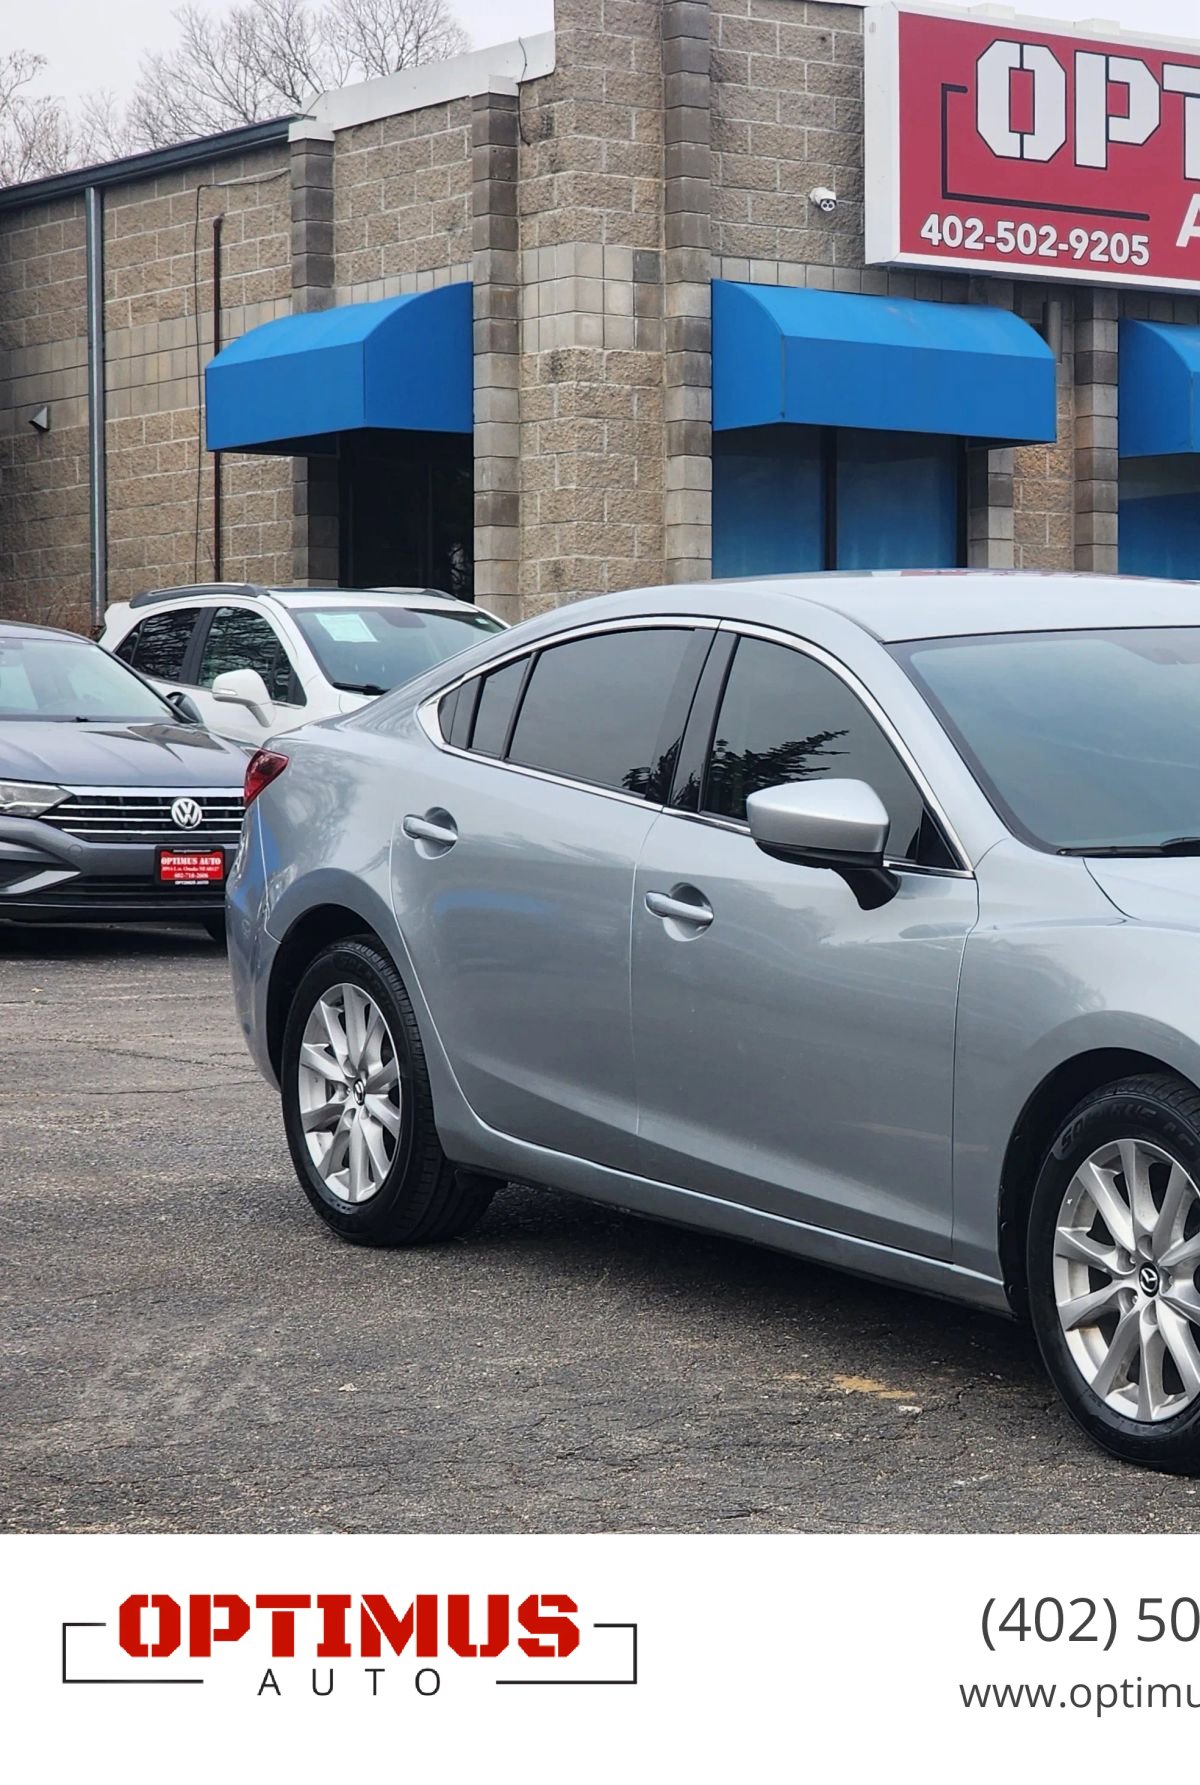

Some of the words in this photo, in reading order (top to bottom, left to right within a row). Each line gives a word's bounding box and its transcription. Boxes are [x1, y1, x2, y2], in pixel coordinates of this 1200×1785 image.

[919, 213, 1150, 267] 402-502-9205
[160, 857, 198, 866] OPTIMUS
[199, 857, 222, 866] AUTO
